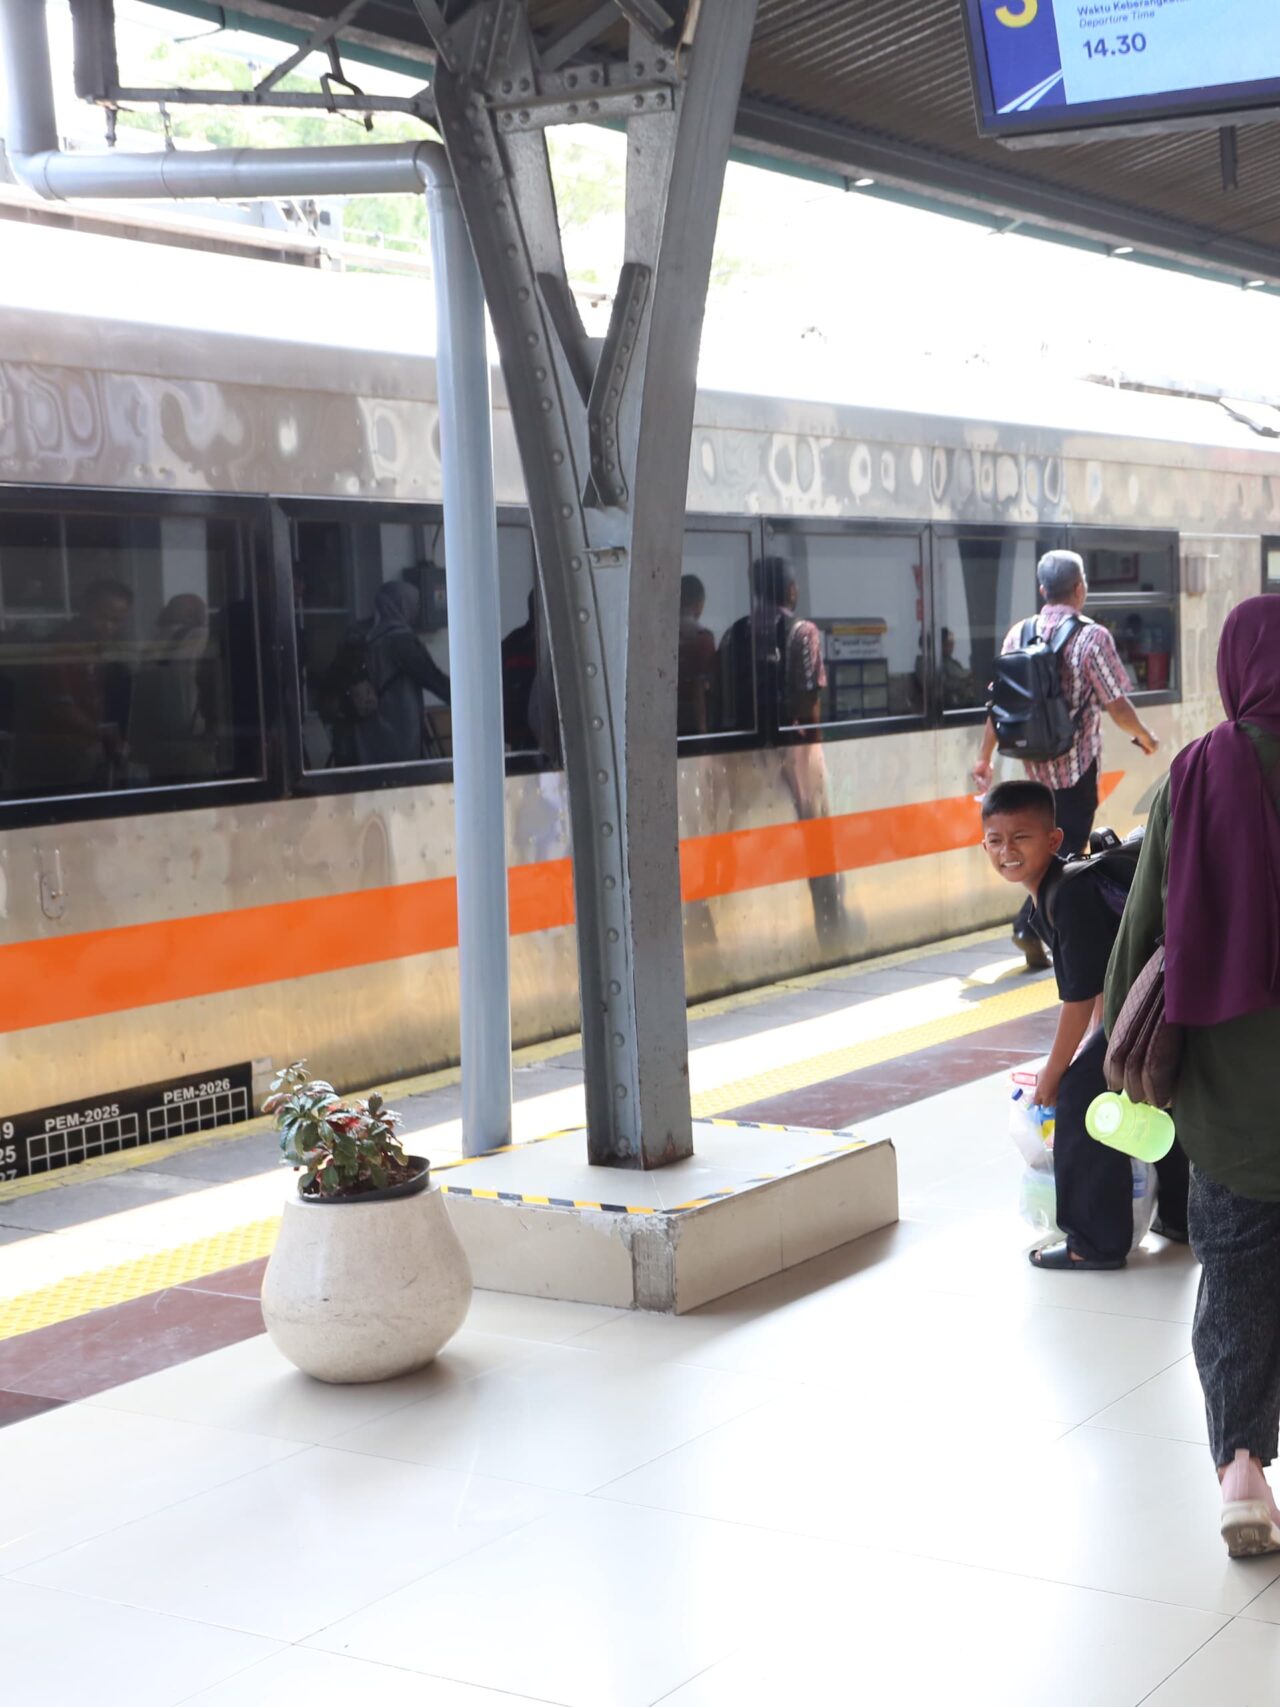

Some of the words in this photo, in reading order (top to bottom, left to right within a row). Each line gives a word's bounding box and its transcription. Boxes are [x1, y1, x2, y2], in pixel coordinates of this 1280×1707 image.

[1077, 5, 1111, 17] Waktu
[1079, 14, 1129, 29] Departure
[1132, 10, 1155, 21] Time
[1082, 32, 1147, 59] 14.30
[163, 1078, 231, 1104] PEM-2026
[45, 1104, 120, 1132] PEM-2025
[0, 1121, 15, 1140] 9
